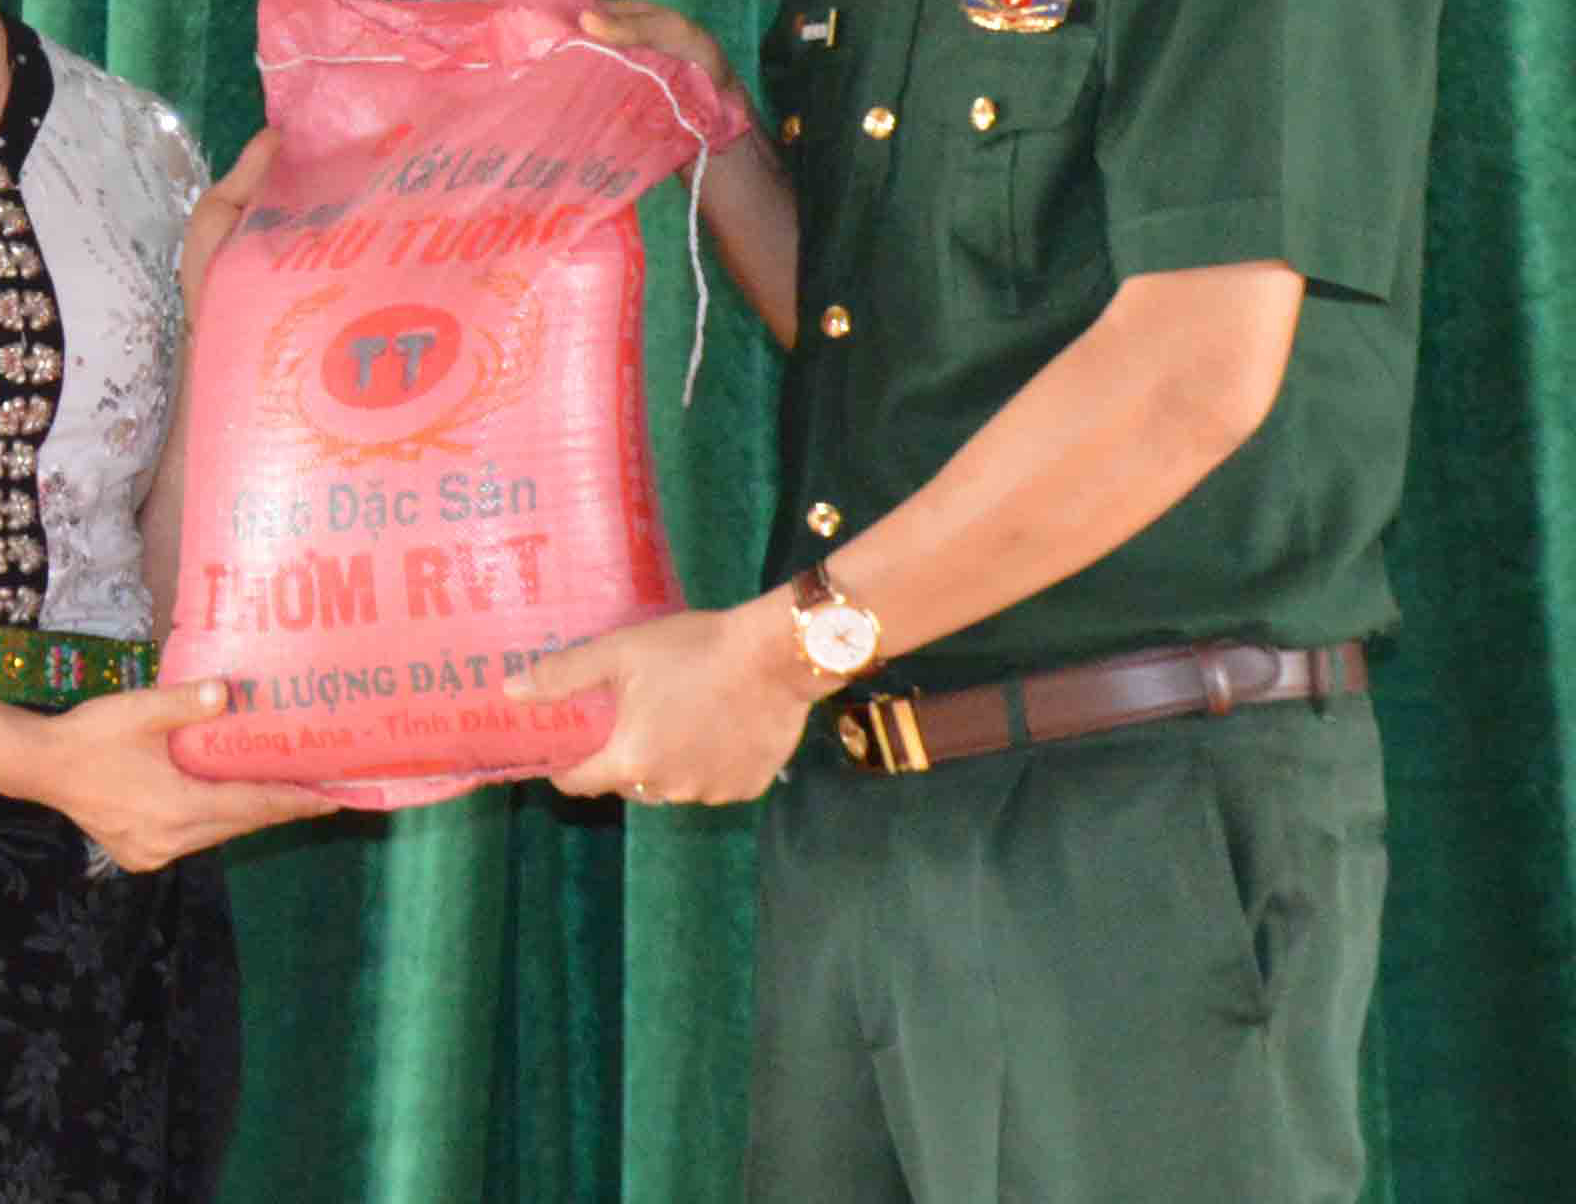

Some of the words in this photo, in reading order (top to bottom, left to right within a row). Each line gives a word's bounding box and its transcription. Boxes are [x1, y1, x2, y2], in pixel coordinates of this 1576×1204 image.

[327, 478, 421, 542] Đặc
[439, 459, 539, 524] Sản
[199, 548, 380, 633] THƠM
[404, 532, 552, 621] RVT
[270, 665, 398, 714] LƯỢNG
[201, 727, 294, 759] Krông
[294, 724, 355, 752] Ana
